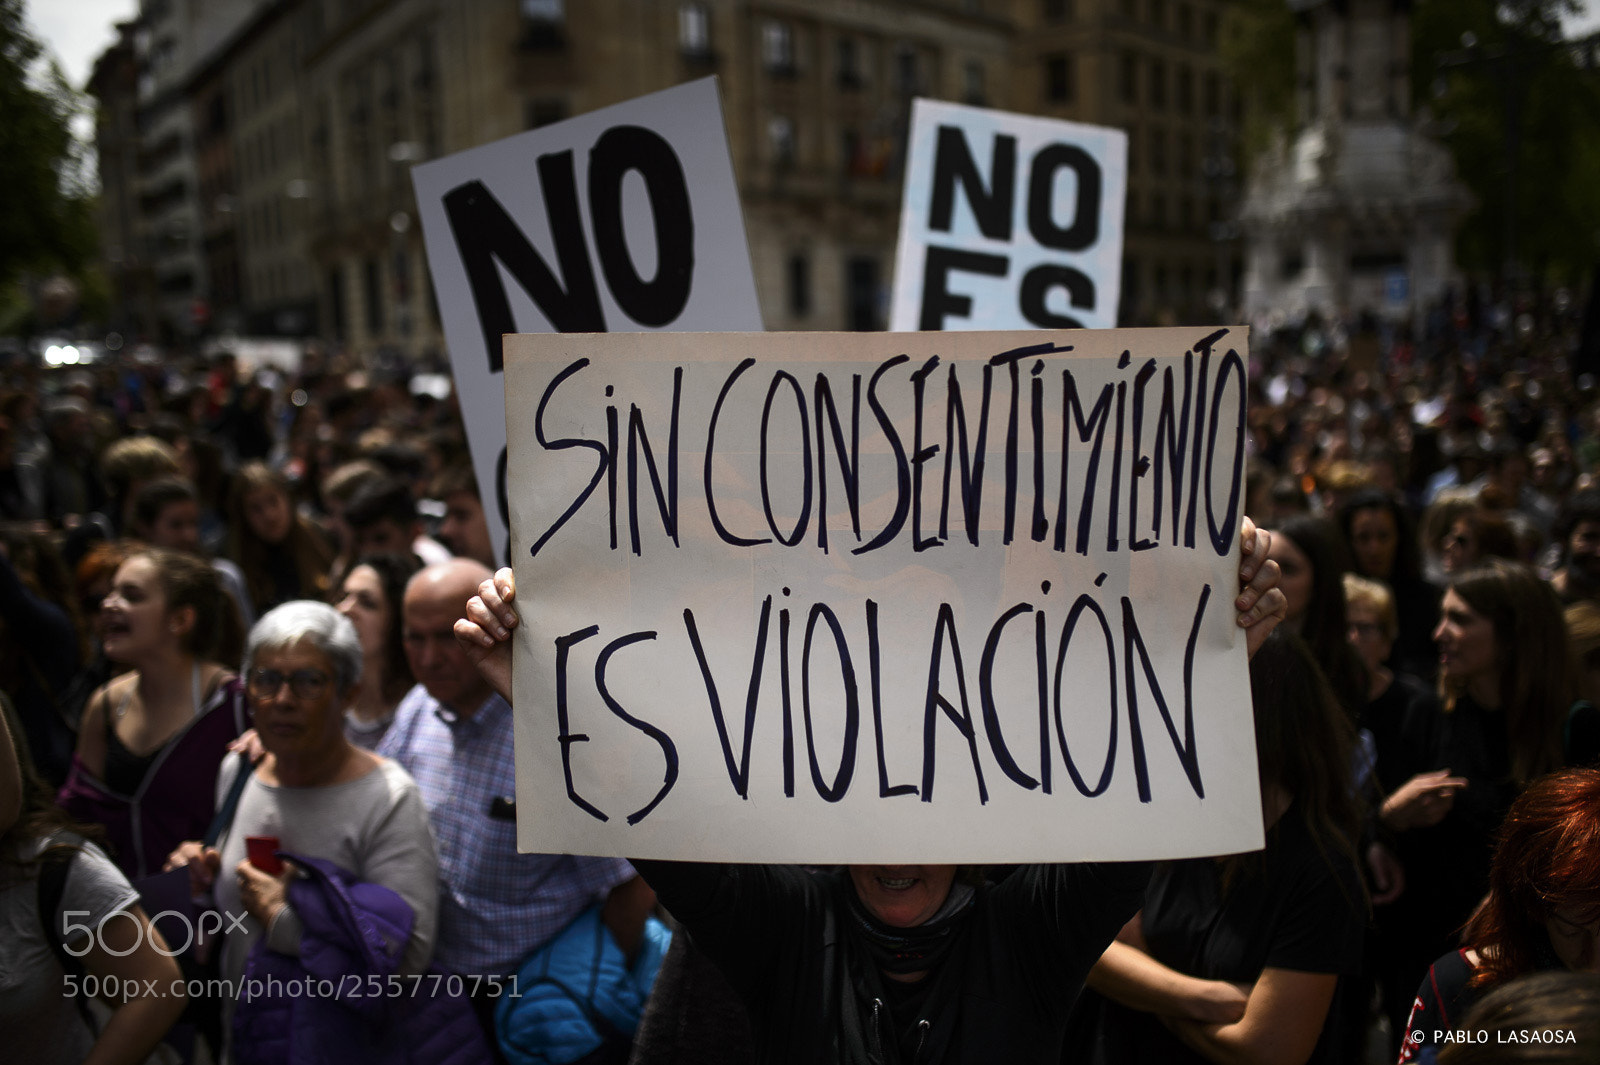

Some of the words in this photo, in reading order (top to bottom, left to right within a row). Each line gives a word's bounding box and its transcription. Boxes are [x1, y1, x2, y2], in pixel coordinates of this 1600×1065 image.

[441, 124, 695, 373] NO
[928, 126, 1103, 252] NO
[556, 624, 679, 824] ES
